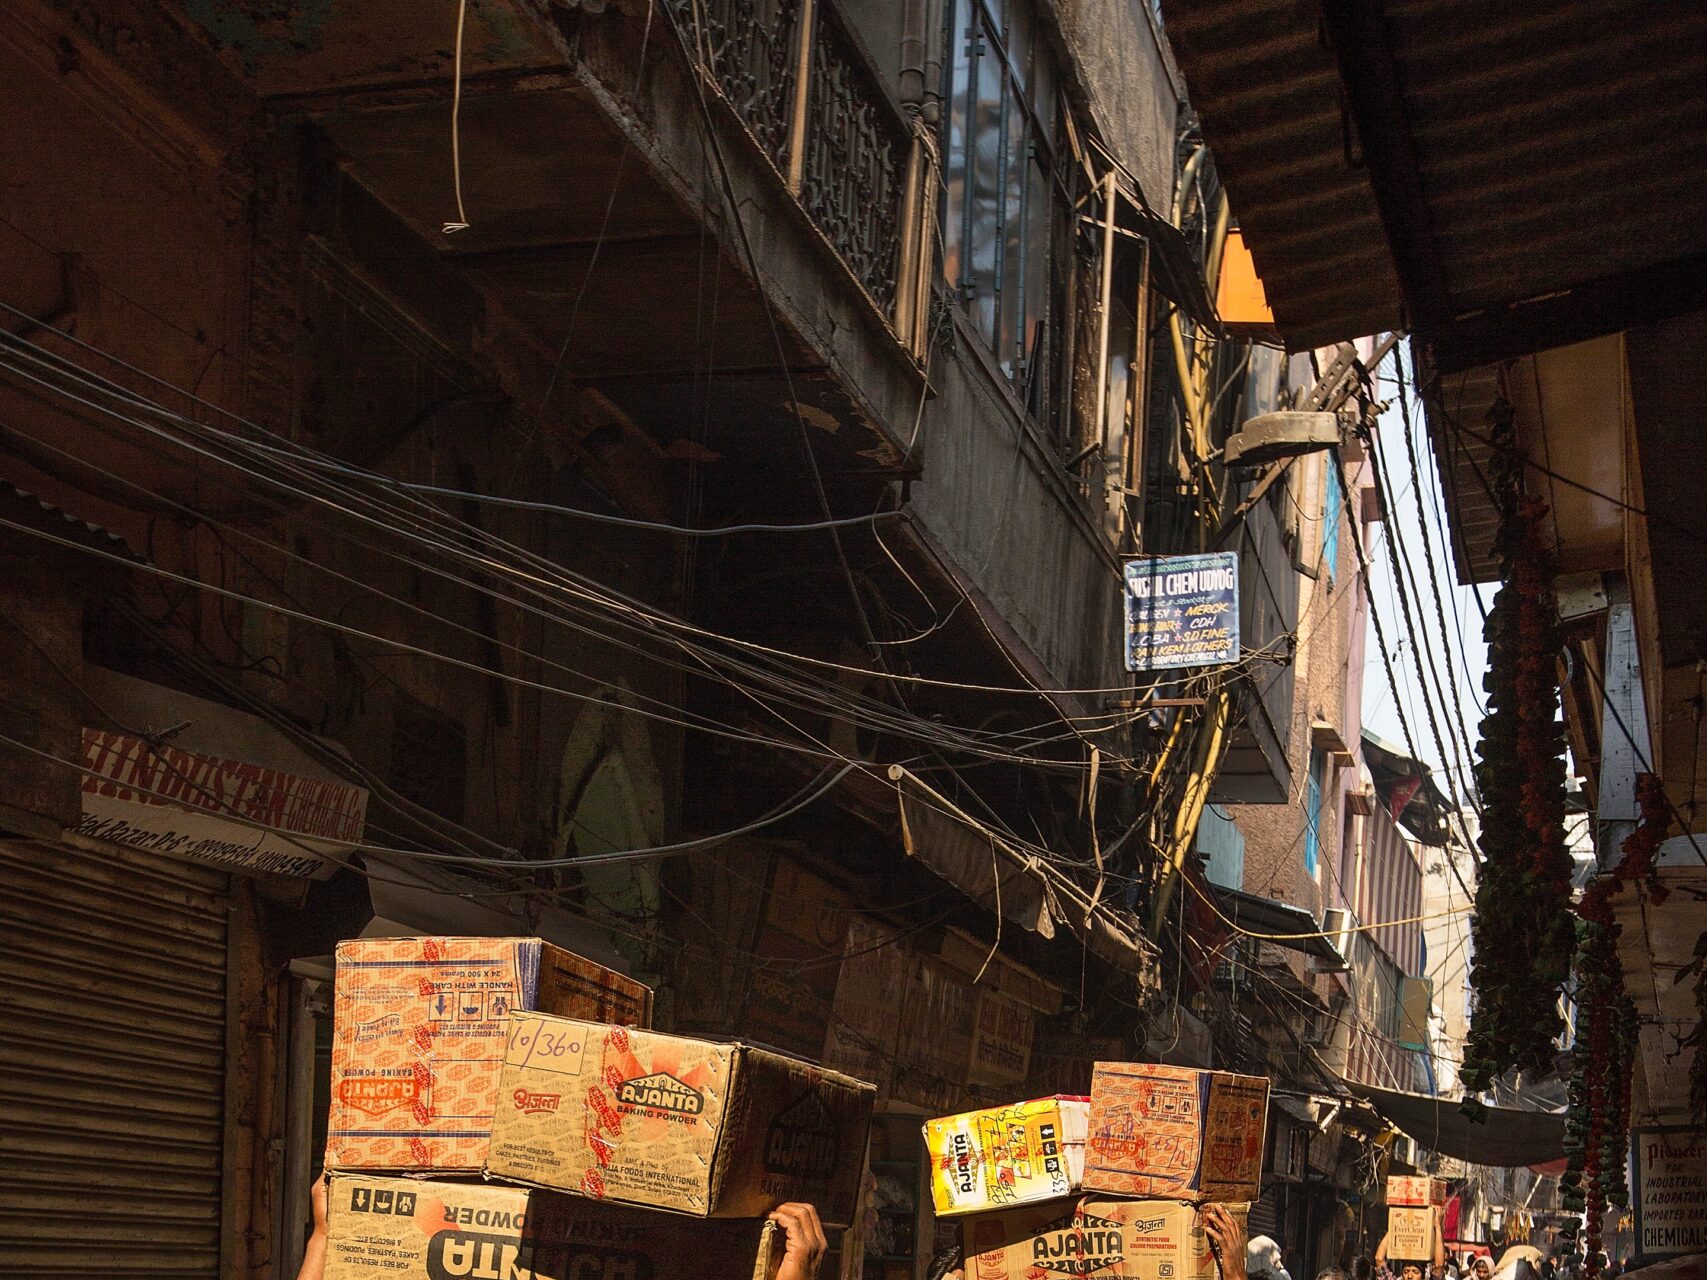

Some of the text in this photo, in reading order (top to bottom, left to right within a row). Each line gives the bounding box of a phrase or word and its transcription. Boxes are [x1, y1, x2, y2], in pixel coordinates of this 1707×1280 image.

[1166, 571, 1198, 595] CHEM
[1199, 568, 1234, 592] UDYOG
[1185, 603, 1230, 617] MERCK
[1190, 616, 1217, 630] CDH
[1191, 638, 1233, 652] OTHERS
[81, 728, 297, 830] HINDUSTAN
[440, 970, 466, 979] Grams
[467, 970, 481, 978] 500
[491, 970, 501, 978] 24
[454, 981, 477, 990] WITH
[478, 981, 513, 990] HANDLE
[380, 1068, 413, 1078] BAKING
[340, 1081, 415, 1098] AJANTA
[513, 1088, 561, 1114] अजन्ता
[621, 1086, 698, 1113] AJANTA
[617, 1105, 698, 1126] BAKING POWDER
[954, 1133, 972, 1192] AJANTA
[619, 1165, 644, 1178] FOODS
[645, 1170, 701, 1188] INTERNATIONAL
[1647, 1176, 1705, 1188] INDUSTRIAL
[1644, 1208, 1707, 1220] IMPORTED RAR
[1135, 1218, 1165, 1234] अजन्ता
[369, 1236, 396, 1246] BISCUITS
[1033, 1231, 1123, 1259] AJANTA
[1129, 1242, 1178, 1250] COLOUR PREPARATIONS
[336, 1244, 366, 1254] PUDDINGS
[353, 1257, 379, 1266] RESULTS
[978, 1252, 1004, 1261] AJANTA
[379, 1260, 396, 1268] BEST
[396, 1262, 409, 1270] FOR
